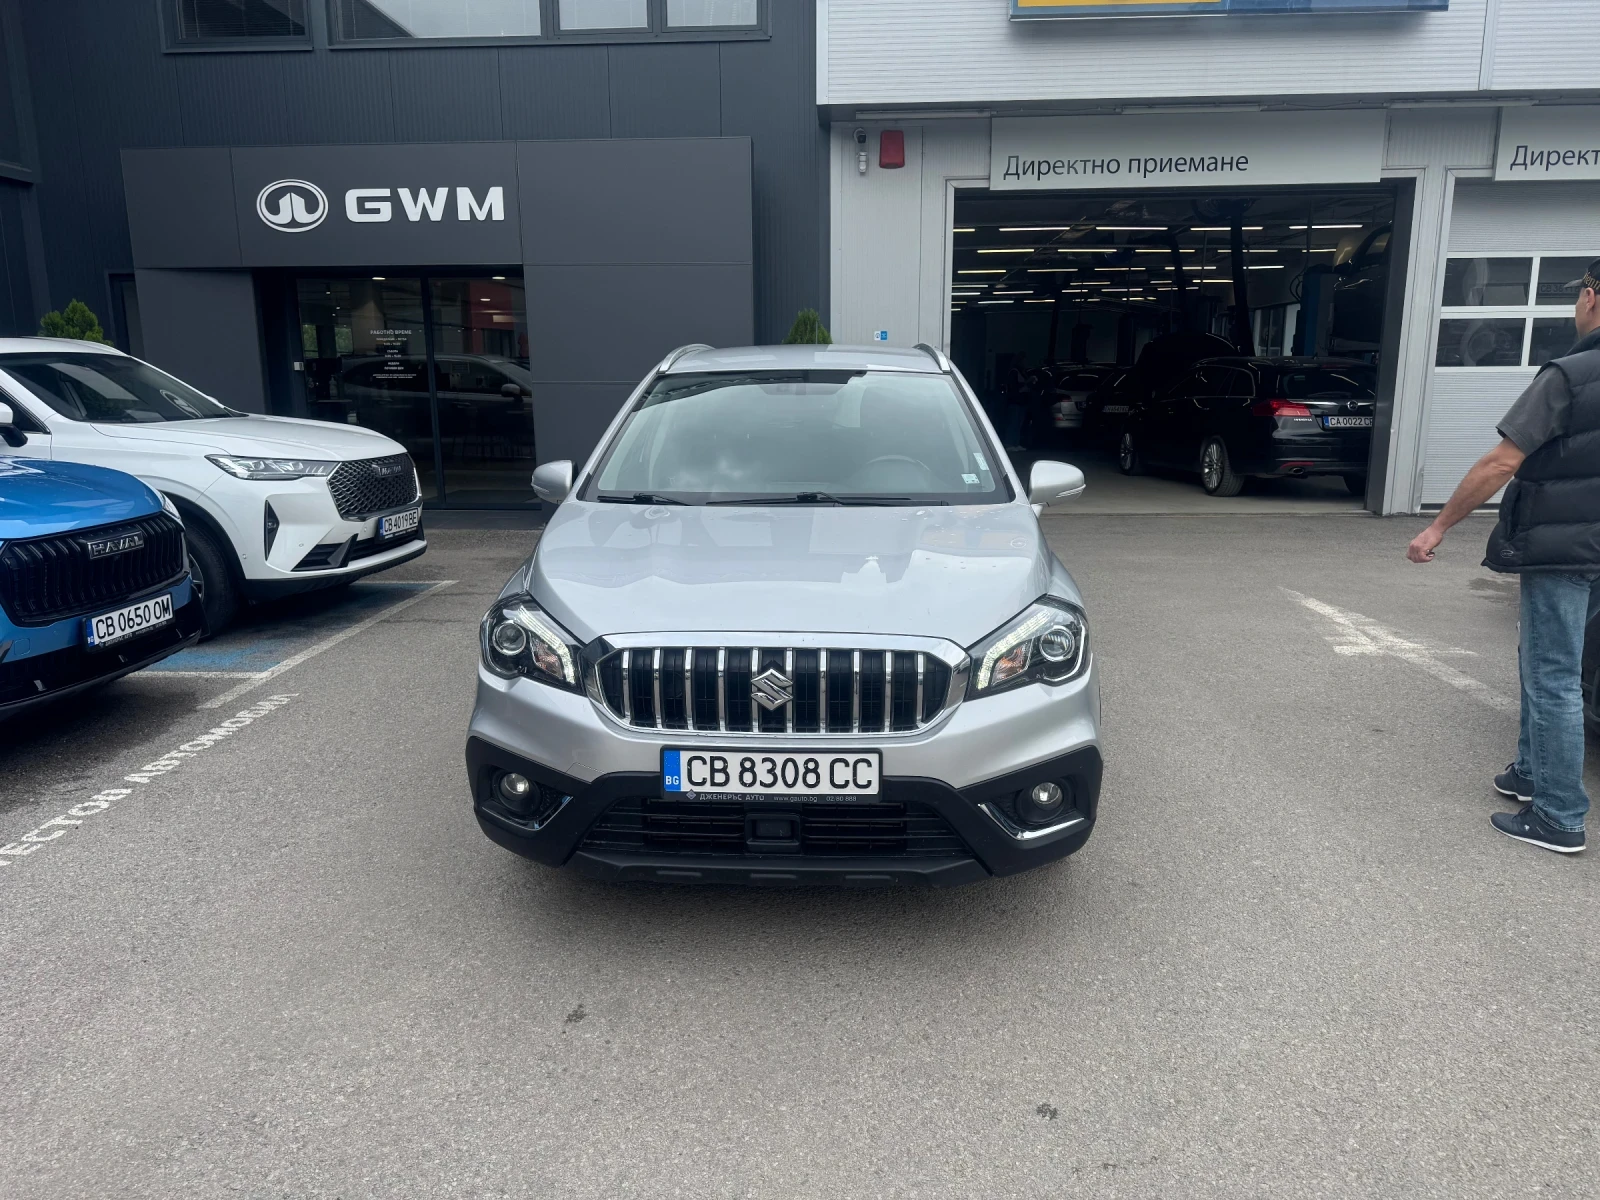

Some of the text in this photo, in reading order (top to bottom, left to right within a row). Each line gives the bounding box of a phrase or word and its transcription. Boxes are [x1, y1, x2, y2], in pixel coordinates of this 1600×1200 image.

[1003, 155, 1249, 181] Директно приемане
[1509, 145, 1600, 172] Директ
[345, 186, 505, 223] GWM
[1329, 417, 1342, 427] CA
[1342, 417, 1363, 426] 0022
[383, 517, 393, 533] CB
[393, 513, 409, 529] 4019
[409, 511, 417, 526] BE
[92, 535, 143, 556] HAVAL
[95, 616, 116, 640] CB
[118, 604, 152, 632] 0650
[153, 597, 171, 620] OM
[124, 693, 300, 784] АВТОМОБИЛ
[665, 755, 873, 790] BG CB 8308 CC
